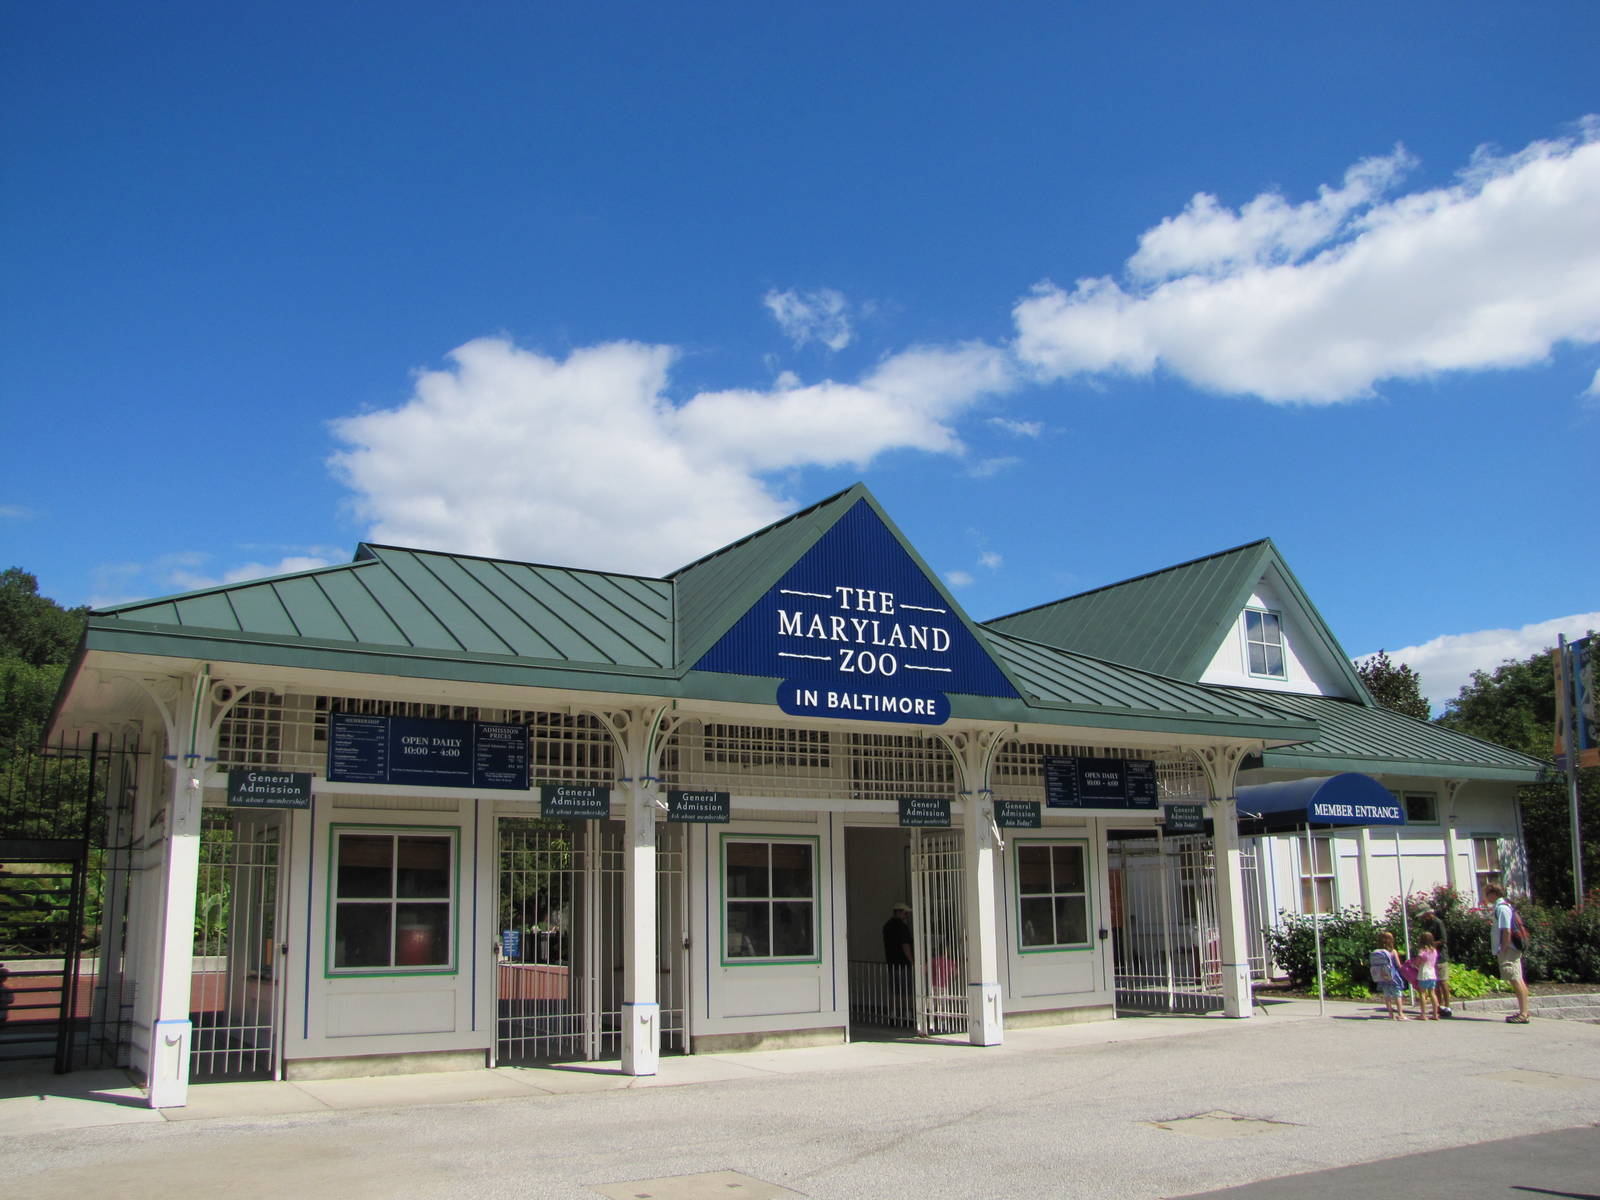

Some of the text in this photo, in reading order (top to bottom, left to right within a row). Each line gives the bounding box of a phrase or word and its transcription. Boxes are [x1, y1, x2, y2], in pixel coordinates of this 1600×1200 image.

[836, 586, 895, 615] THE
[777, 609, 951, 652] MARYLAND
[839, 648, 897, 676] ZOO
[796, 689, 936, 715] IN BALTIMORE
[482, 727, 519, 735] ADMISSION
[401, 736, 462, 747] OPEN DAILY
[403, 746, 428, 755] 10:00
[439, 748, 460, 757] 4:00
[248, 772, 294, 784] General
[1084, 771, 1100, 779] OPEN
[1102, 772, 1119, 780] DAILY
[240, 783, 301, 794] Admission
[557, 786, 595, 797] General
[551, 796, 602, 807] Admission
[682, 792, 717, 802] General
[676, 801, 723, 811] Admission
[910, 800, 940, 808] General
[906, 808, 945, 816] Admission
[1314, 803, 1400, 819] MEMBER ENTRANCE
